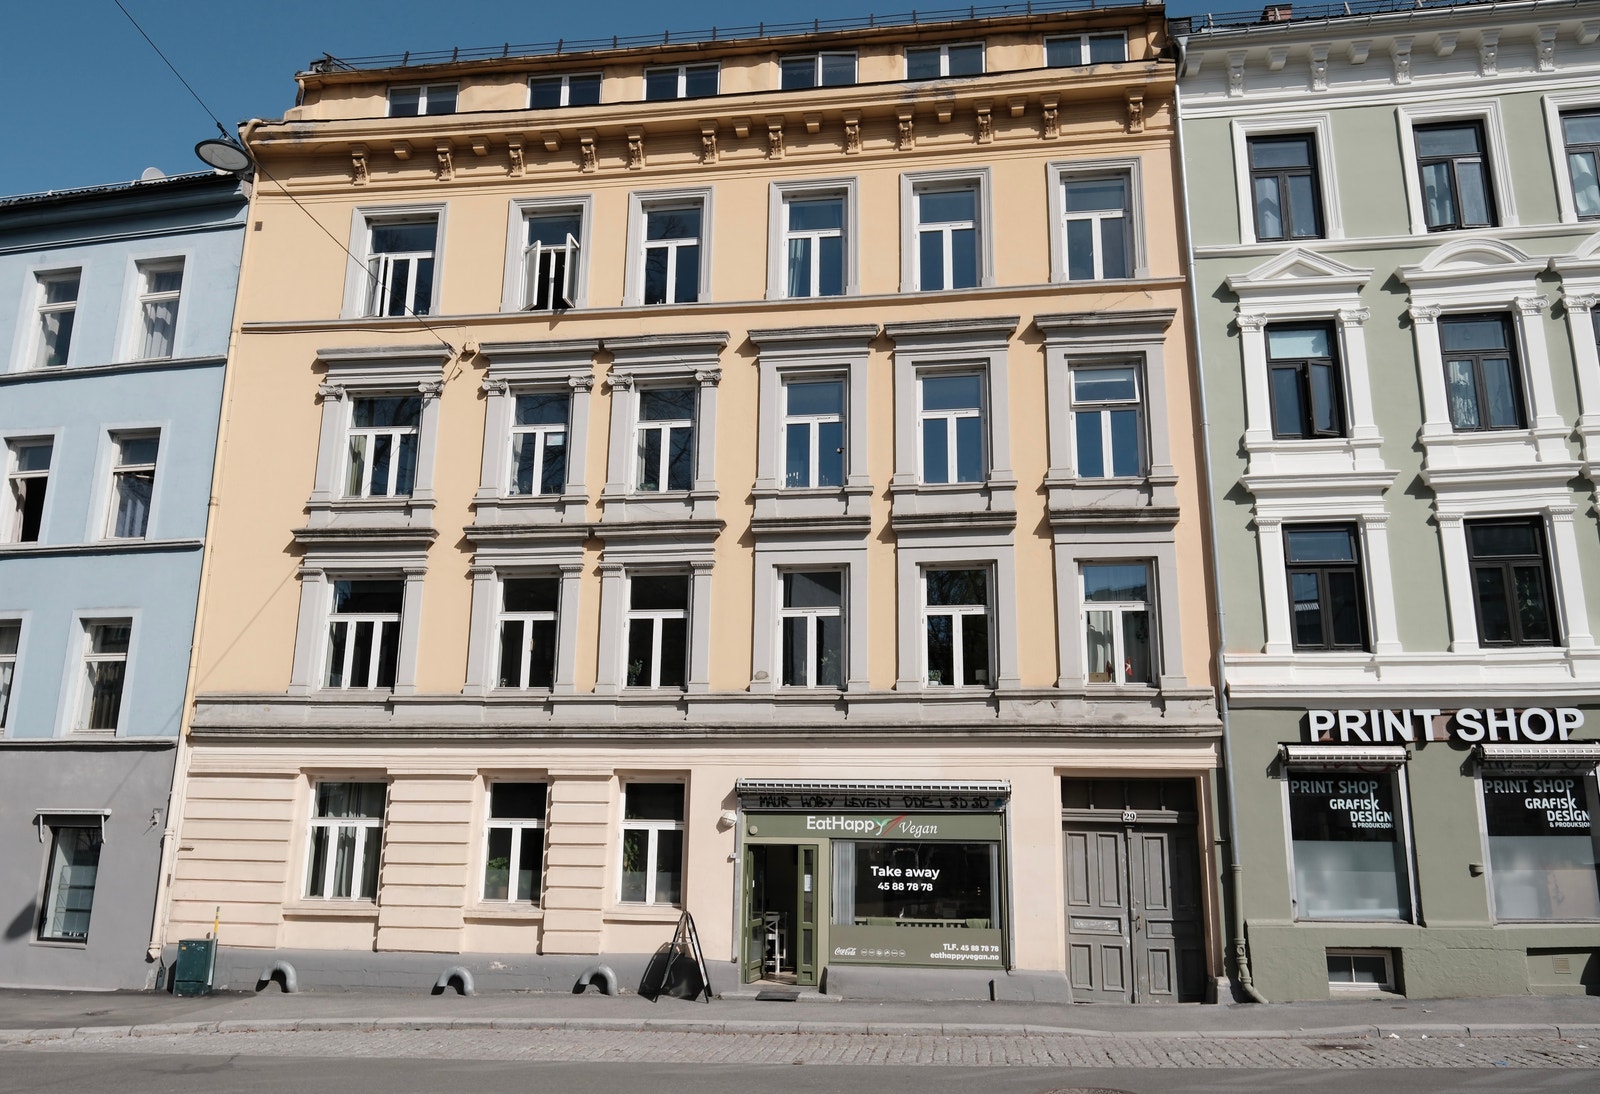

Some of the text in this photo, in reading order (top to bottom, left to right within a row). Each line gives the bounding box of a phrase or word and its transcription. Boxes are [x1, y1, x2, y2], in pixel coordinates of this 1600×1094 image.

[1308, 707, 1585, 742] PRINT SHOP
[1290, 780, 1379, 794] PRINT SHOP
[1484, 779, 1575, 793] PRINT SHOP
[1329, 798, 1380, 810] GRAFISK
[1524, 797, 1578, 809] GRAFISK
[1124, 812, 1135, 821] 29
[1350, 811, 1393, 822] DESIGN
[1546, 810, 1590, 821] DESIGN
[806, 815, 938, 838] EatHappy Vegan
[870, 865, 940, 880] Take away
[877, 882, 933, 891] 45 88 78 78
[943, 943, 959, 951] TLF.
[930, 952, 1000, 960] eathappyvegan.no
